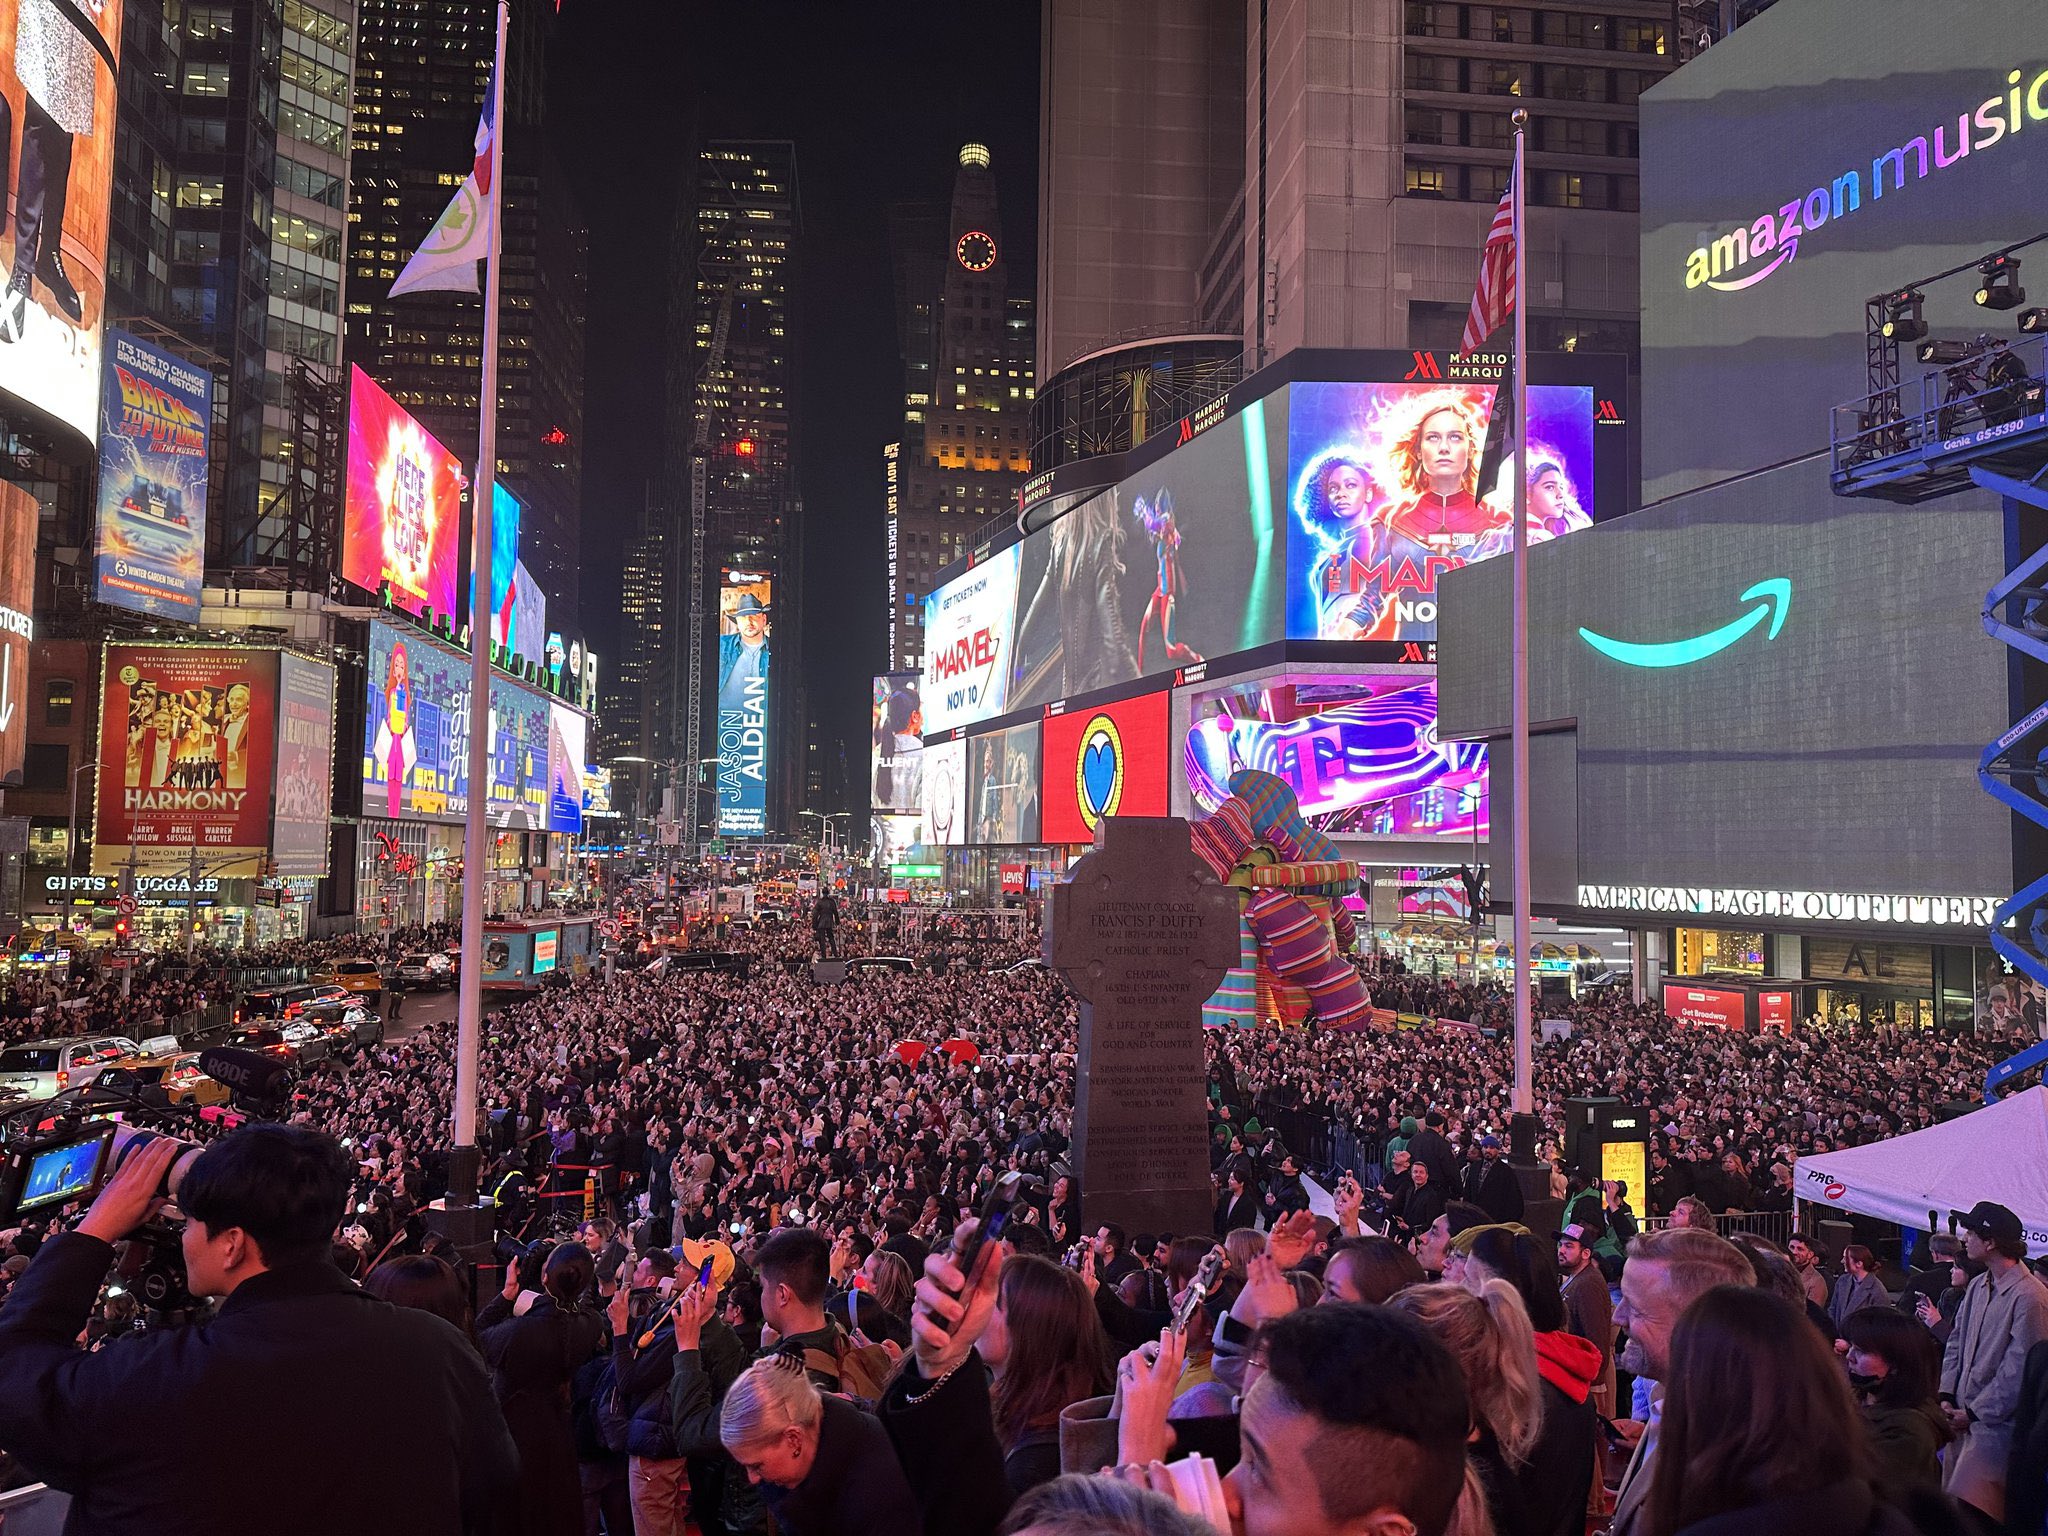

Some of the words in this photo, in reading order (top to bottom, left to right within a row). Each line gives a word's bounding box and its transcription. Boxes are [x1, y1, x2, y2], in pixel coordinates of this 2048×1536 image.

[1684, 169, 1861, 290] amazon
[117, 339, 134, 353] IT'S
[136, 348, 156, 365] TIME
[158, 358, 170, 371] TO
[171, 366, 205, 388] CHANGE
[1450, 353, 1507, 365] MRRIO
[117, 350, 167, 380] BROADWAY
[168, 373, 205, 398] HISTORY!
[1450, 367, 1503, 379] MARQU
[113, 363, 205, 427] BACK
[123, 405, 142, 424] TO
[1195, 393, 1229, 421] MARRIOTT
[141, 412, 204, 448] FUTURE
[1194, 409, 1225, 433] MARQUIS
[1944, 437, 1971, 450] Genie
[1976, 419, 2024, 442] GS-5390
[161, 444, 175, 453] THE
[176, 446, 203, 456] MUSICAL
[396, 453, 425, 501] HERE
[887, 461, 897, 482] NOV
[888, 484, 897, 494] 11
[1025, 471, 1055, 494] MARRIOTT
[1025, 485, 1050, 505] MARQUIS
[888, 496, 897, 515] SAT
[888, 518, 897, 560] TICKETS
[128, 566, 147, 579] WINTER
[147, 571, 166, 584] GARDEN
[1329, 554, 1341, 592] THE
[943, 596, 954, 610] GET
[954, 585, 973, 605] TICKETS
[974, 577, 988, 594] NOW
[1395, 601, 1437, 622] NO
[947, 688, 965, 711] NOV
[968, 685, 978, 705] 10
[741, 676, 766, 781] ALDEAN
[124, 788, 247, 811] HARMONY
[722, 813, 760, 823] Highway
[171, 826, 192, 834] BRUCE
[46, 876, 106, 891] GIFTS
[135, 878, 218, 892] UGGAGE
[1097, 902, 1151, 912] LIEUTENANT
[1154, 903, 1197, 912] COLONEL
[1579, 885, 1699, 912] AMERICAN
[1712, 890, 1793, 917] EAGLE
[1091, 914, 1144, 928] FRANCIS
[1161, 915, 1206, 928] DUFFY
[1097, 931, 1115, 939] MAY
[1105, 946, 1152, 956] CATHOLIC
[1156, 946, 1190, 956] PRIEST
[1125, 970, 1170, 979] CHAPLAIN
[1682, 1008, 1694, 1017] Get
[1694, 1009, 1727, 1021] Broadway
[1116, 1021, 1136, 1029] LIFE
[1138, 1021, 1151, 1029] OF
[1154, 1021, 1191, 1029] SERVICE
[1102, 1040, 1125, 1049] GOD
[1126, 1040, 1147, 1049] AND
[1150, 1040, 1194, 1049] COUNTRY
[207, 1056, 251, 1089] RØDE
[1100, 1064, 1132, 1073] SPANISH
[1134, 1064, 1176, 1072] AMERICAN
[1177, 1064, 1195, 1072] WAR
[1176, 1076, 1205, 1084] GUARD
[1807, 1170, 1834, 1185] PRG
[2021, 1229, 2048, 1243] g.co
